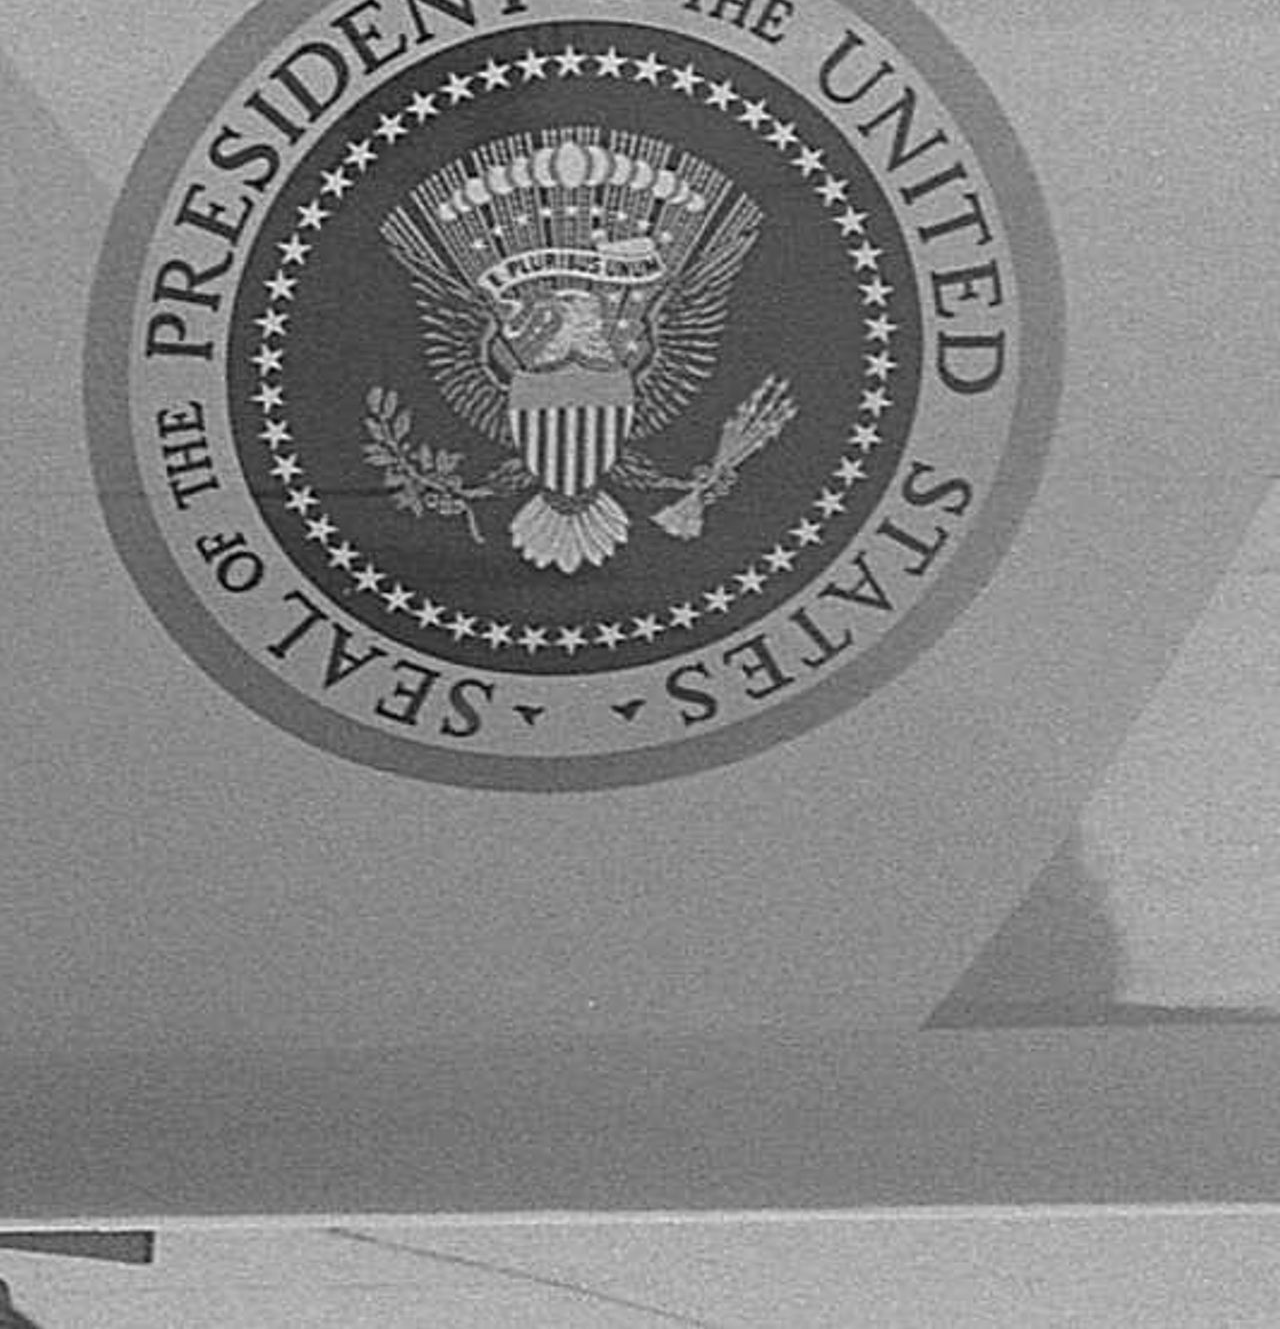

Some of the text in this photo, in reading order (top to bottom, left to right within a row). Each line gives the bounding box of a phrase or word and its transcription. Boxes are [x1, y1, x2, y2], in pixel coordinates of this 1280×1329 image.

[818, 29, 1005, 396] UNITED
[156, 399, 218, 509] THE
[196, 530, 265, 594] OF
[666, 461, 972, 726] STATES
[268, 591, 495, 737] SEAL
